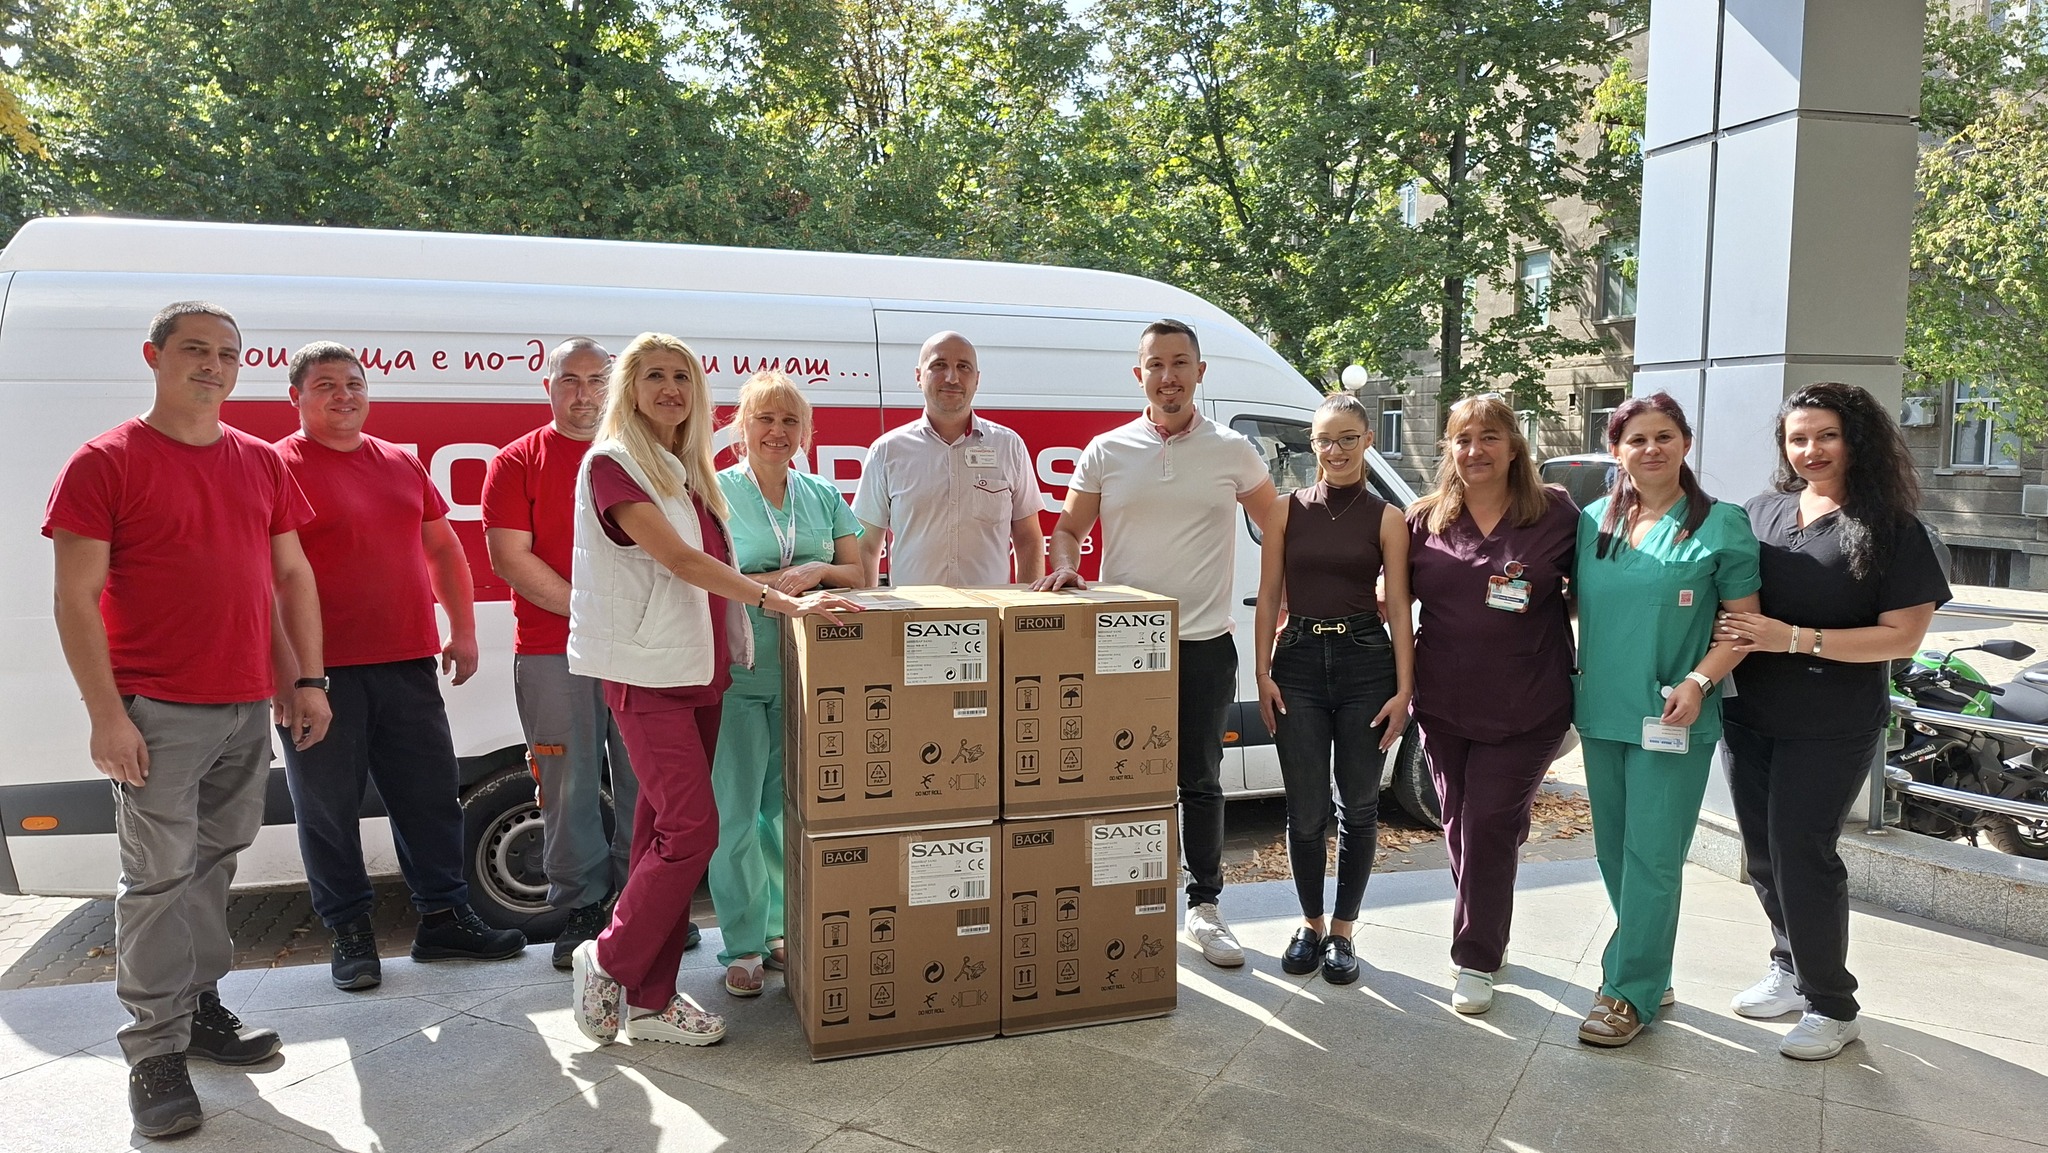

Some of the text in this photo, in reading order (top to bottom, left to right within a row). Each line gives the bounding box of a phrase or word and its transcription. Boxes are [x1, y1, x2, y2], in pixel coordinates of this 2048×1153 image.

[1018, 617, 1061, 629] FRONT
[1098, 614, 1165, 627] SANG
[820, 626, 857, 638] BACK
[907, 623, 980, 637] SANG
[1094, 823, 1161, 840] SANG
[1015, 832, 1049, 846] BACK
[911, 840, 983, 857] SANG
[825, 850, 862, 864] BACK
